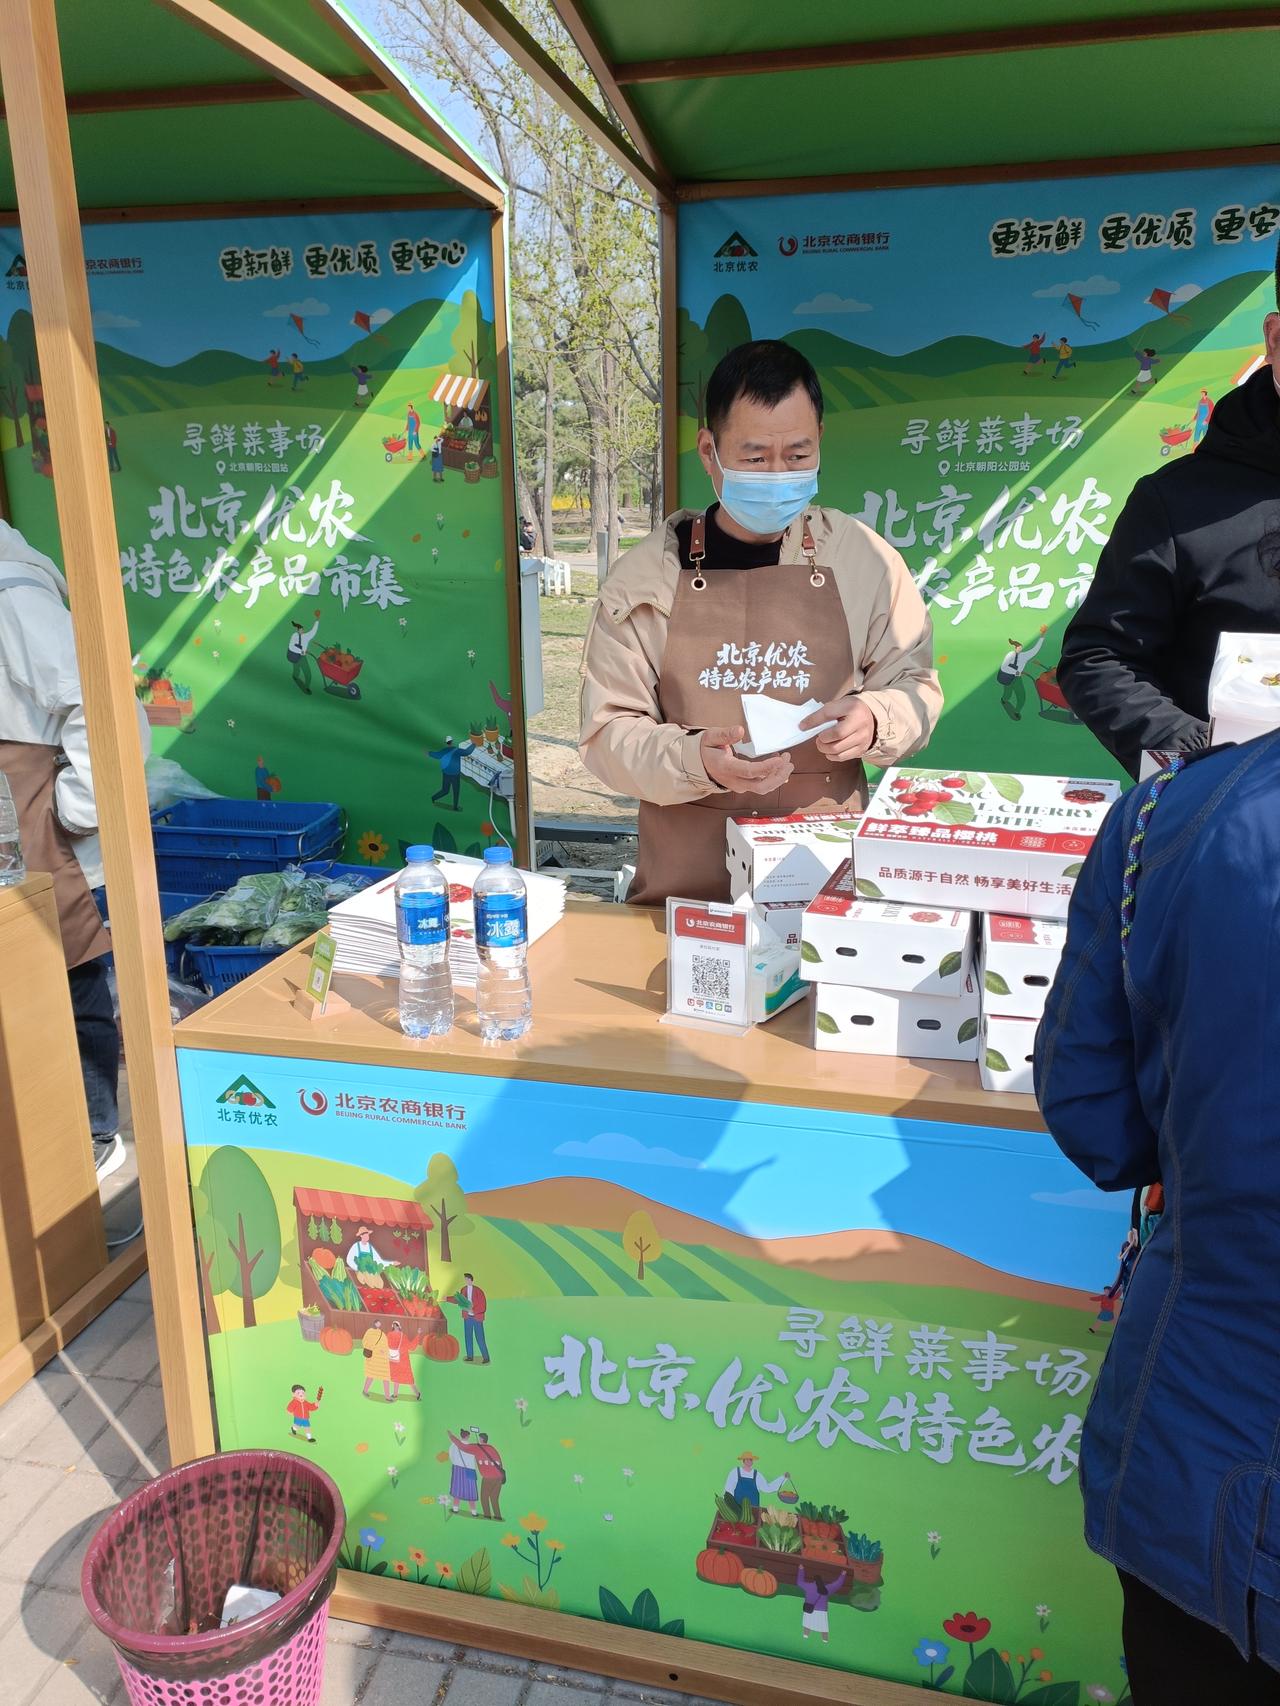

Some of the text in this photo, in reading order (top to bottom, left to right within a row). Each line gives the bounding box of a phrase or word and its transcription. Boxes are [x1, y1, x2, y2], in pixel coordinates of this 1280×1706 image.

[803, 231, 890, 248] 北京农商银行
[992, 219, 1083, 254] 更新鲜
[1101, 211, 1193, 249] 更优质
[221, 240, 465, 279] 更新鲜 更优质 更安心
[714, 261, 758, 273] 北京优农
[6, 280, 30, 291] 北京
[183, 420, 325, 458] 寻鲜菜事场
[900, 412, 1085, 456] 寻鲜菜事场
[229, 462, 289, 473] 北京朝阳公园站
[954, 460, 1031, 473] 北京朝阳公园站
[148, 479, 374, 548] 北京优农
[850, 477, 1112, 555] 北京优农
[120, 543, 412, 613] 特色农产品市集
[716, 640, 816, 668] 北京优农
[698, 666, 811, 694] 特色农产品市
[999, 803, 1097, 818] CHERRY
[878, 866, 1072, 896] 品质源于自然 畅享美好生活
[486, 918, 520, 938] 冰露
[217, 1107, 278, 1127] 北京优农
[335, 1092, 466, 1121] 北京农商银行
[335, 1110, 467, 1131] BEIJING RURAL COMMERCIAL BANK
[778, 1306, 1092, 1398] 寻鲜菜事场
[543, 1333, 1083, 1486] 北京优农特色农
